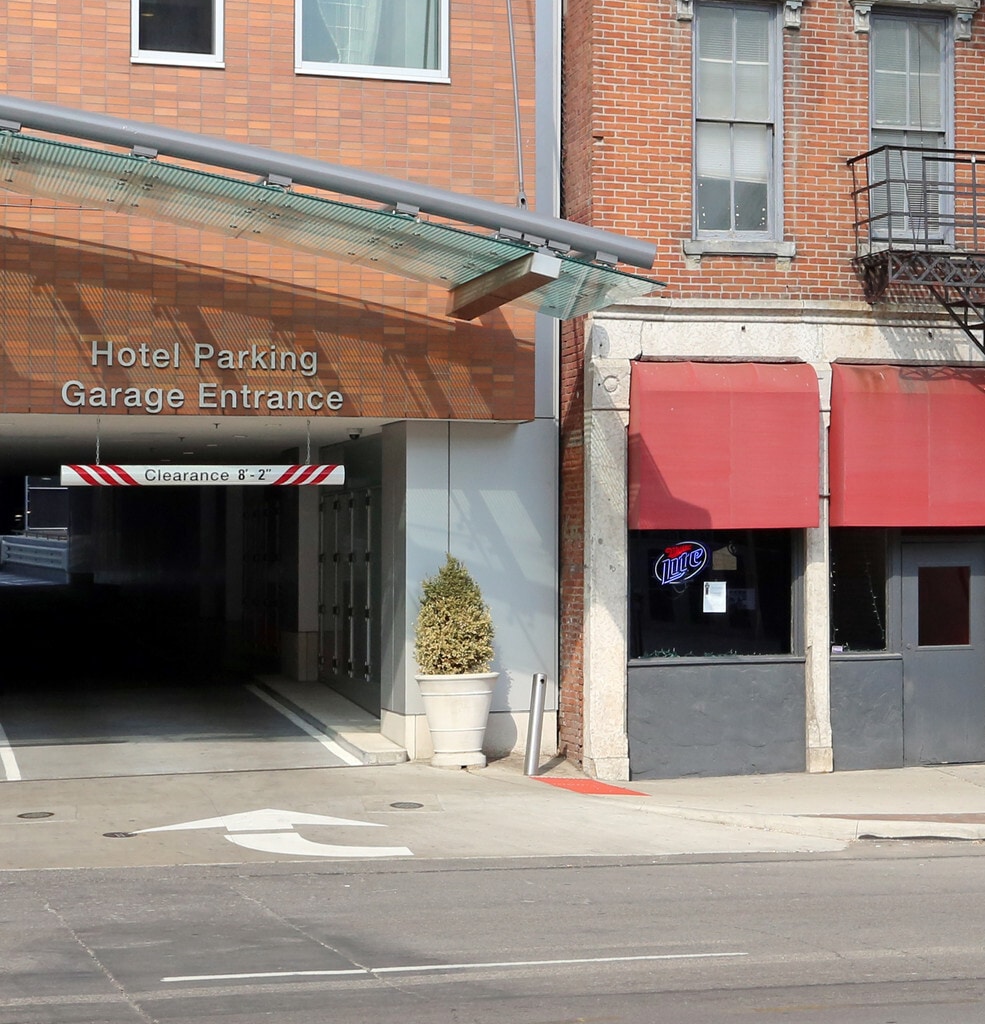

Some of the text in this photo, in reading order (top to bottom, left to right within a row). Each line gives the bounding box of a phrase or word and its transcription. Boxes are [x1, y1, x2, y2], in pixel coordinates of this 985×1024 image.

[91, 340, 319, 377] Hotel Parking
[61, 379, 344, 413] Garage Entrance
[144, 468, 229, 482] Clearance
